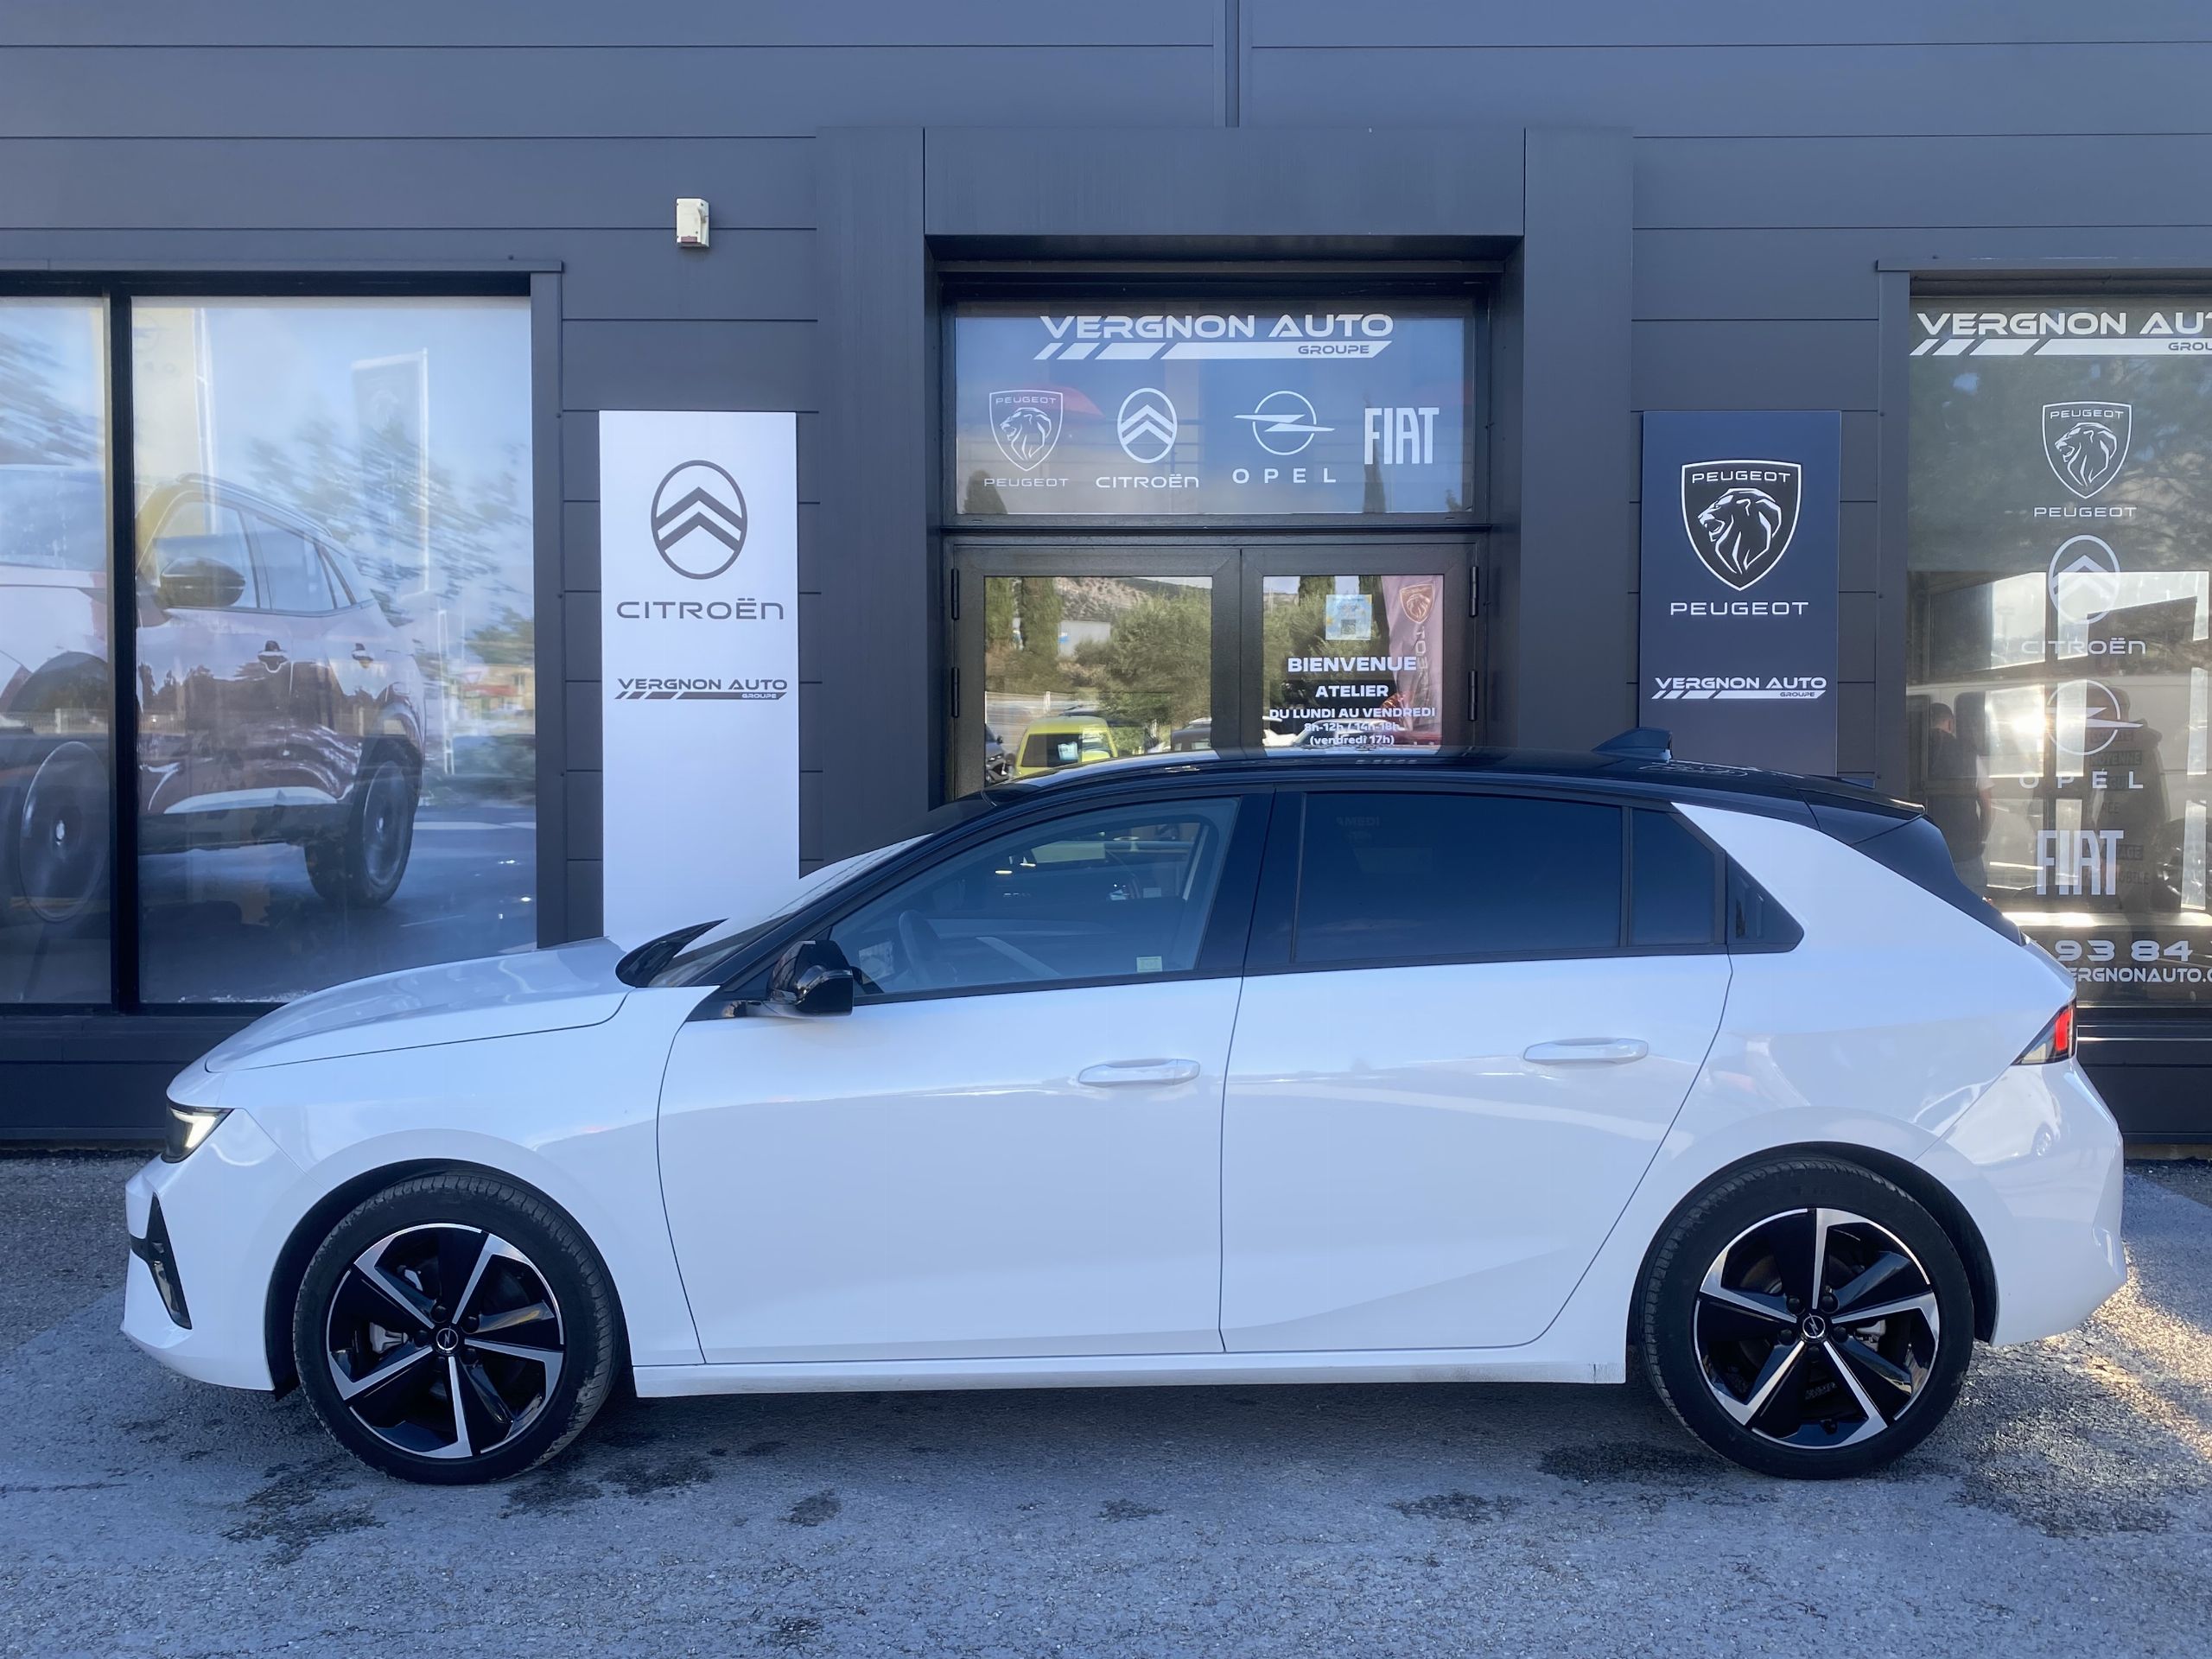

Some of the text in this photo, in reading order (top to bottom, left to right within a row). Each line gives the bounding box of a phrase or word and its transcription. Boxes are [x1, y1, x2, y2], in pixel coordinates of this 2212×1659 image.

[1040, 314, 1393, 338] VERGNON AUTO
[1916, 312, 2127, 335] VERGNON
[1298, 345, 1370, 355] GROUPE
[995, 396, 1056, 405] PEUGEOT
[2050, 409, 2124, 420] PEUGEOT
[1364, 407, 1440, 464] FIAT
[984, 477, 1069, 487] PEUGEOT
[1096, 474, 1199, 488] CITROËN
[1232, 467, 1337, 484] OPEL
[1691, 471, 1791, 484] PEUGEOT
[2034, 506, 2137, 518] PEUGEOT
[616, 597, 785, 620] CITROËN
[1670, 601, 1809, 615] PEUGEOT
[2021, 638, 2146, 655] CITROËN
[1287, 656, 1417, 672] BIENVENUE
[617, 677, 787, 690] VERGNON AUTO
[1315, 684, 1389, 697] ATELIER
[1655, 677, 1827, 690] VERGNON AUTO
[1269, 707, 1435, 719] DU LUNDI AU VENDREDI
[1369, 734, 1395, 745] 17h)
[2018, 771, 2144, 789] OPEL
[2037, 830, 2124, 895] FIAT
[2056, 939, 2193, 962] 93 84
[2068, 968, 2212, 982] ERGNONAUTO.
